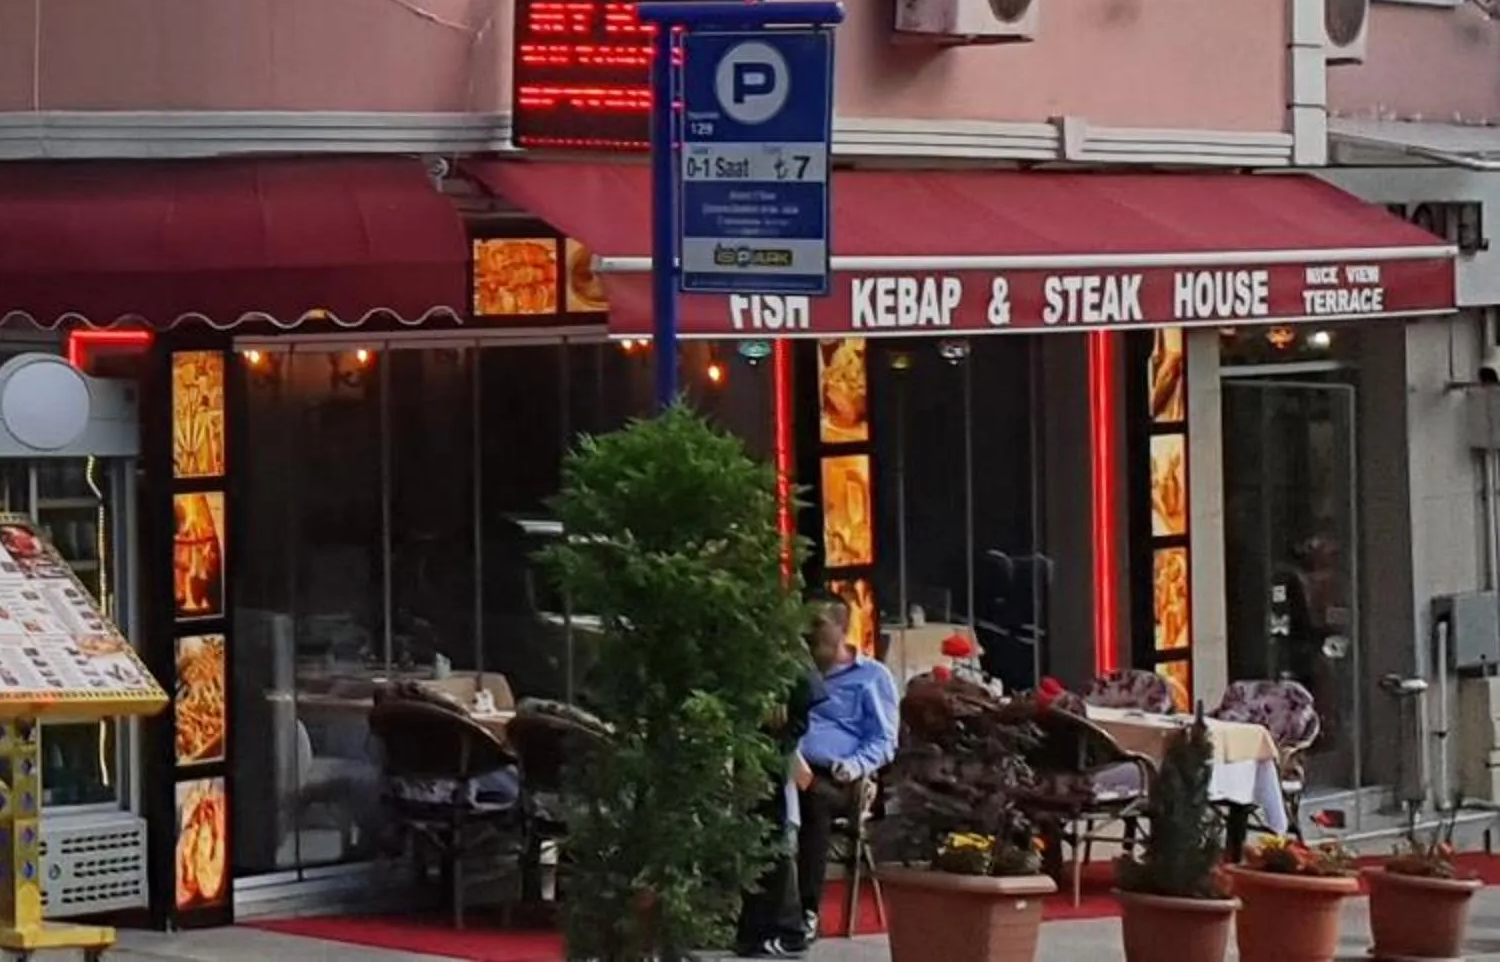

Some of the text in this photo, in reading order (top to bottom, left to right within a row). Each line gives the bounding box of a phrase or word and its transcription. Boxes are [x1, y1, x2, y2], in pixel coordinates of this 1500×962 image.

[733, 62, 776, 104] P
[687, 157, 709, 177] 0-1
[715, 157, 749, 177] Saat
[729, 270, 1269, 330] FISH KEBAP & STEAK HOUSE
[1302, 287, 1384, 315] TERRACE
